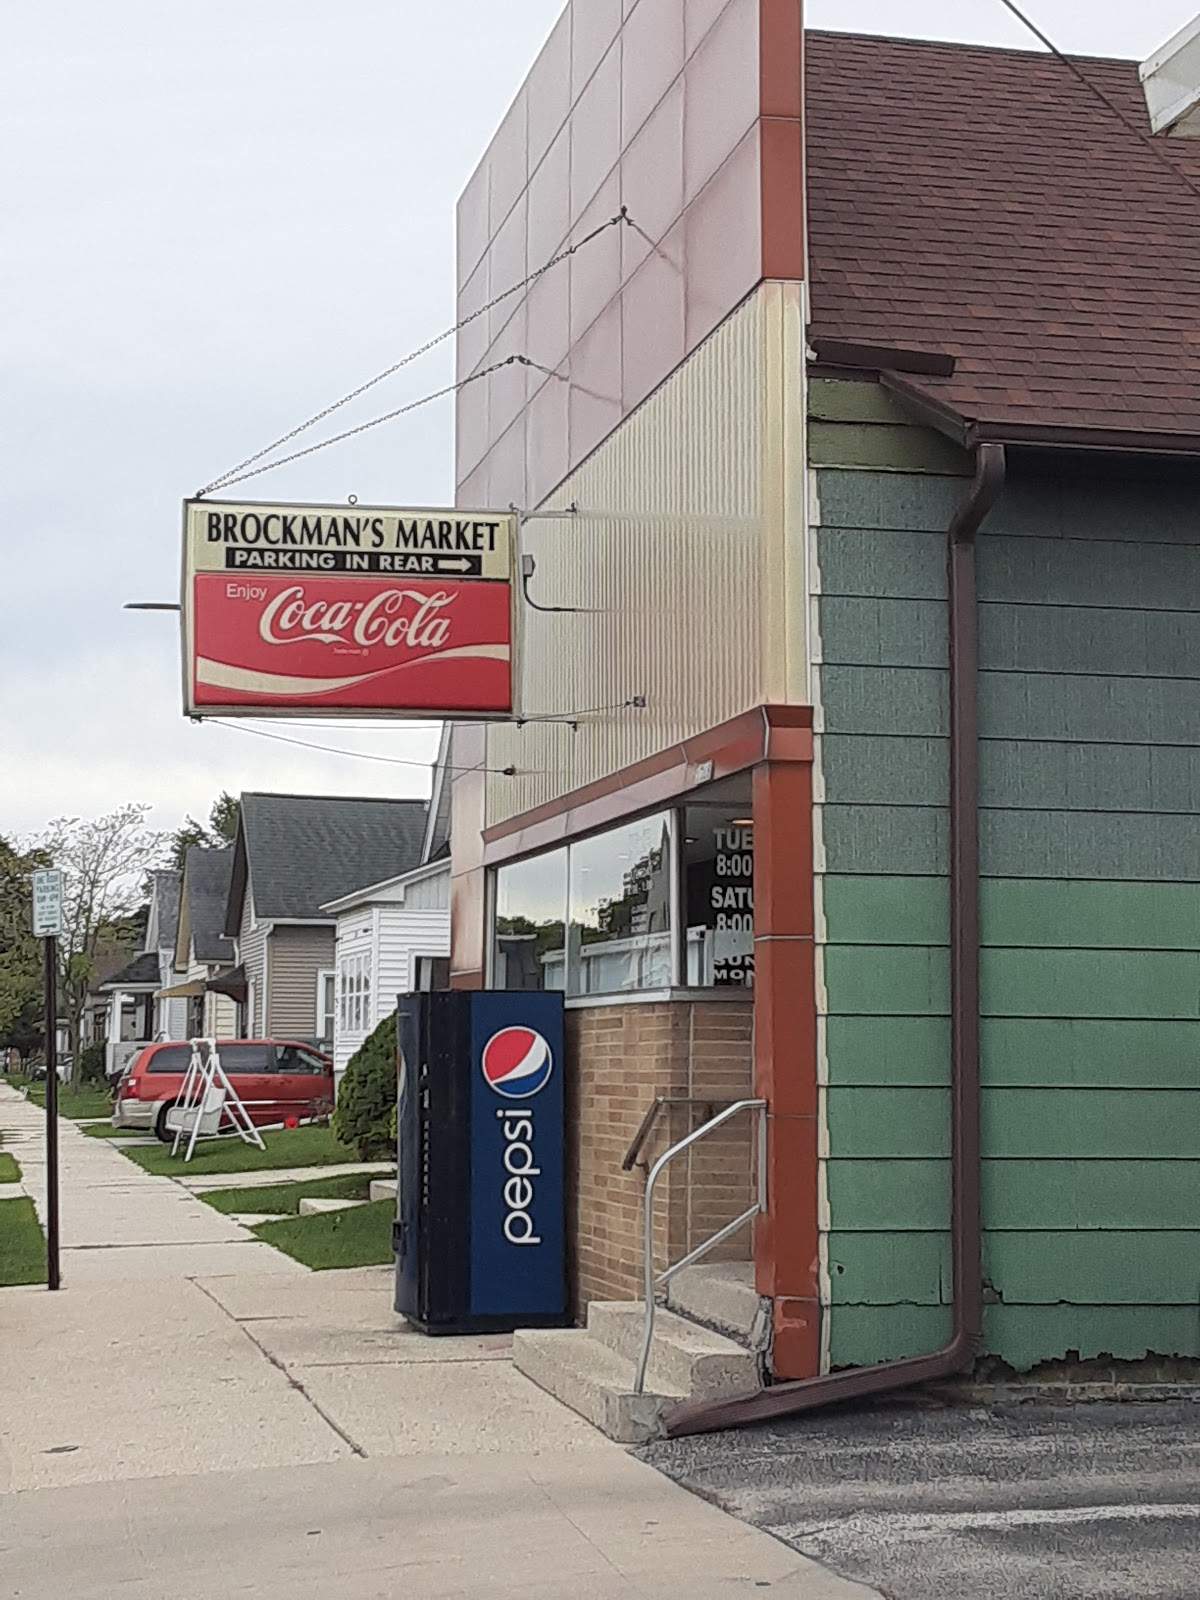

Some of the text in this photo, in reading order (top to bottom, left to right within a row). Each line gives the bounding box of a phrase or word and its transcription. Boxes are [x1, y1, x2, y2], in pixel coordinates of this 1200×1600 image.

[207, 512, 499, 551] BROCKMAN'S MARKET
[234, 550, 434, 572] PARKING IN REAR
[226, 583, 267, 601] Enjoy
[716, 854, 753, 877] 8:00
[496, 1108, 541, 1244] pepsi
